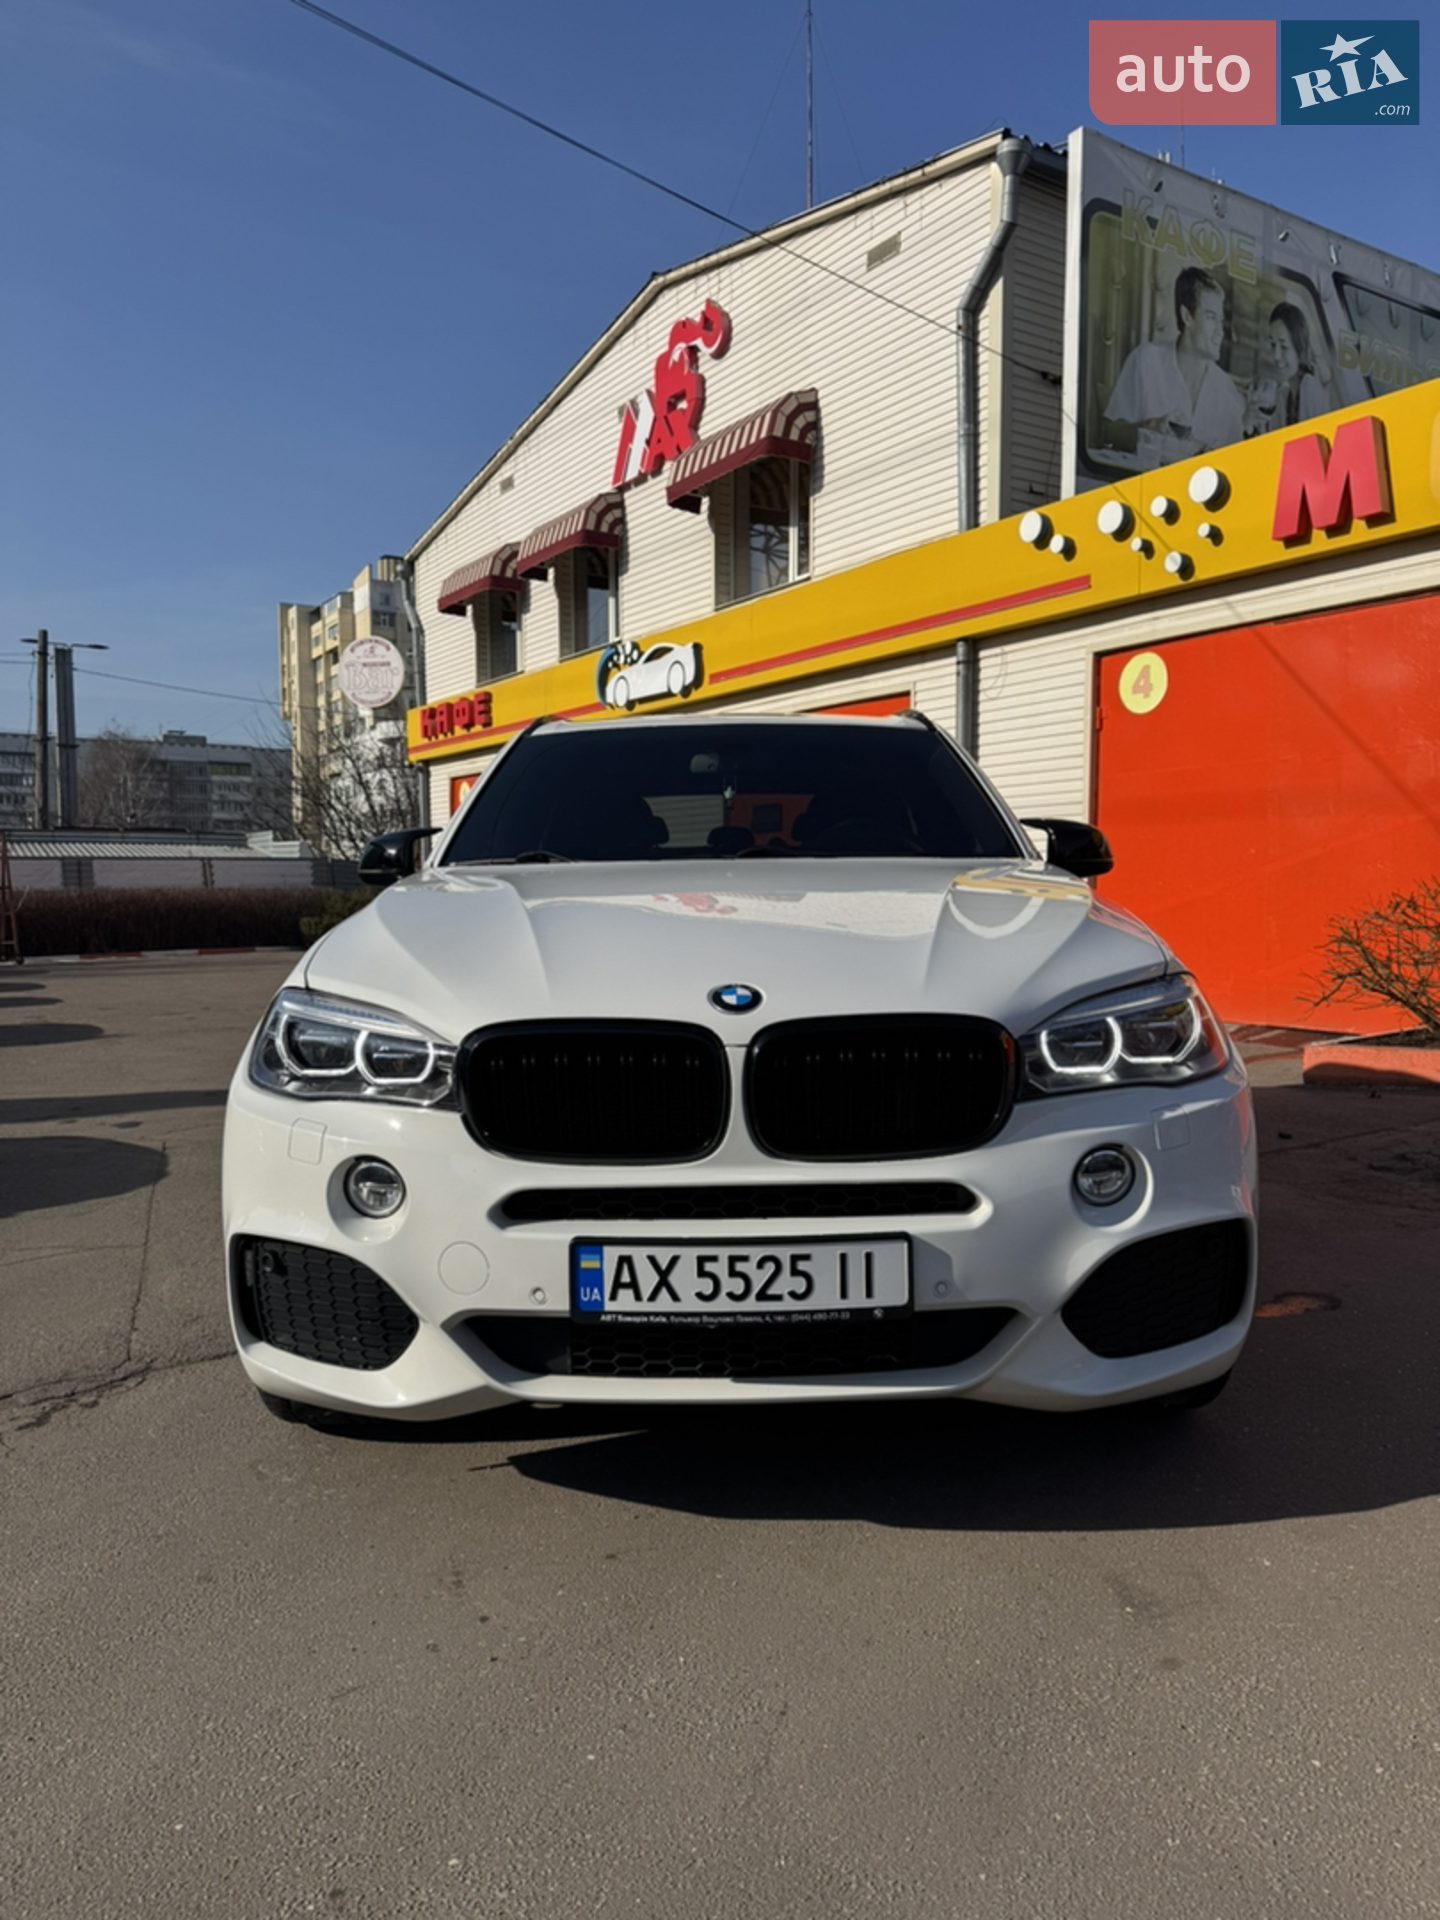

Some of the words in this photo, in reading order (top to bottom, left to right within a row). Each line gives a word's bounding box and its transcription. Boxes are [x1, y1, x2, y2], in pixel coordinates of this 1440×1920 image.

[1121, 188, 1258, 285] КАФЕ
[345, 661, 400, 691] Bar
[1131, 664, 1153, 699] 4
[420, 691, 493, 741] КАФЕ
[580, 1287, 601, 1301] UA
[694, 1253, 814, 1301] 5525
